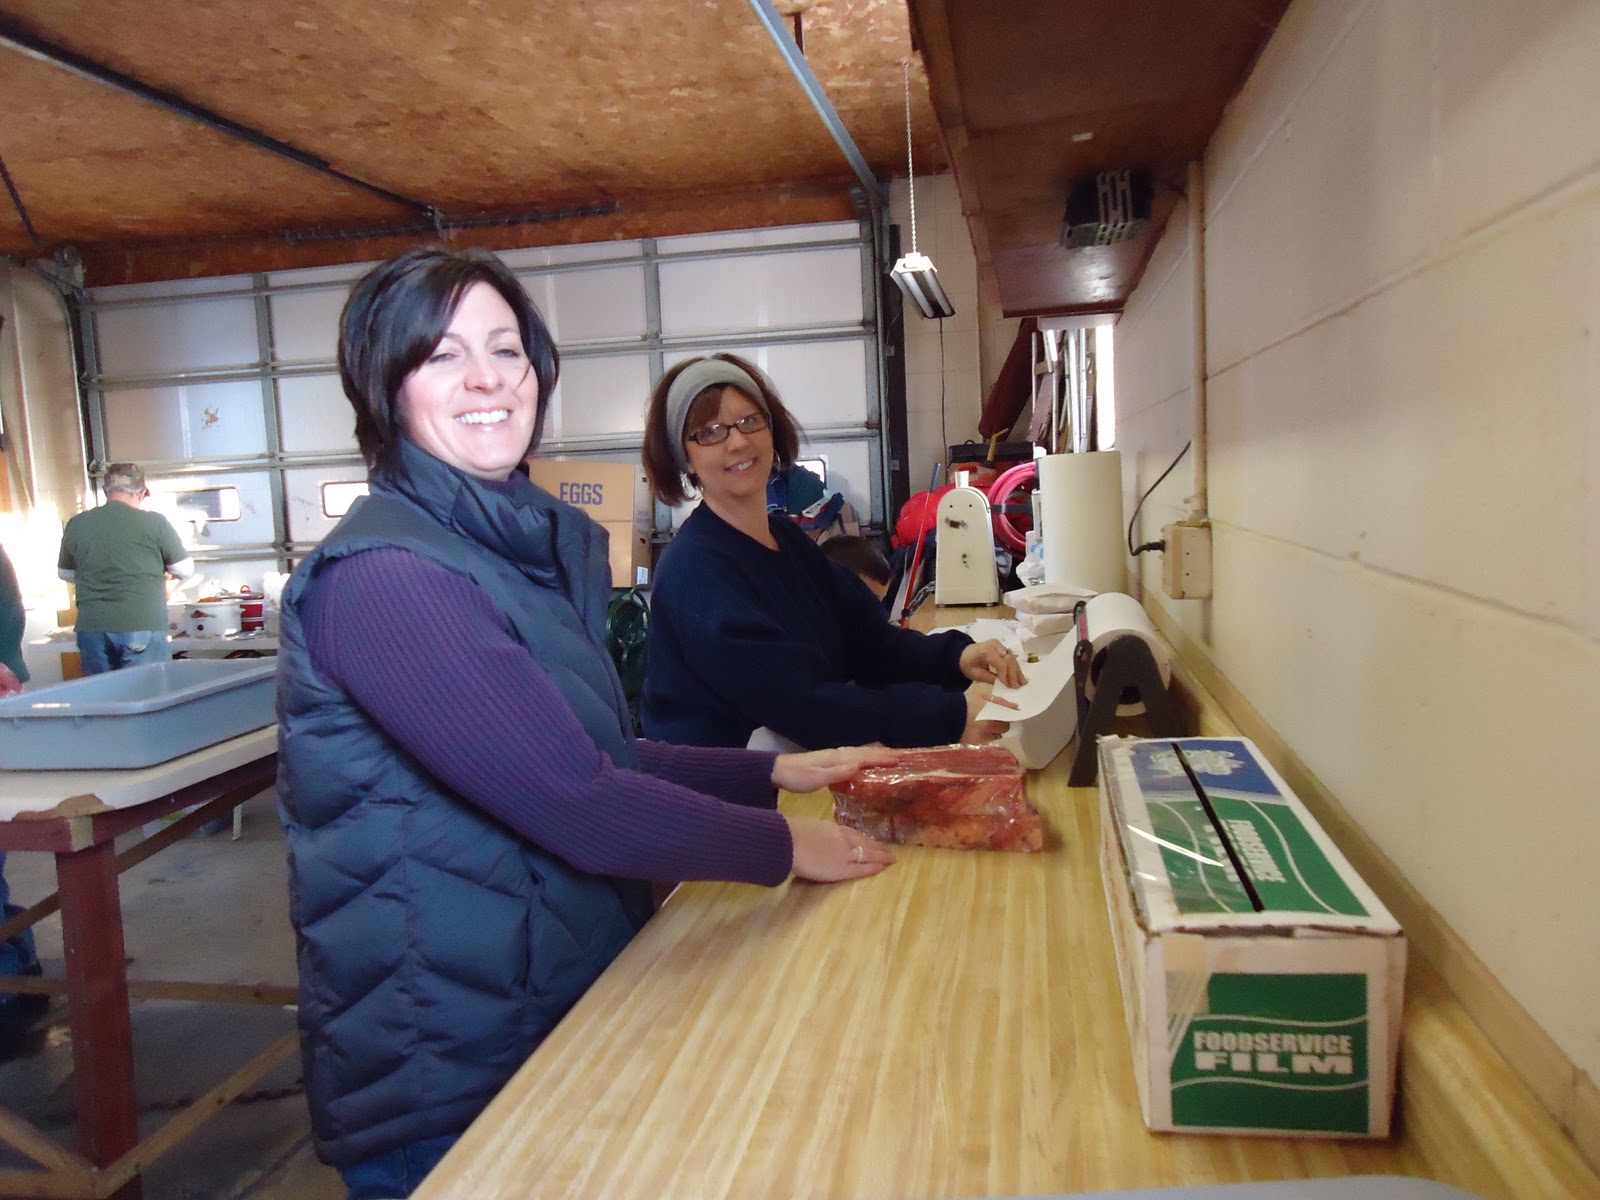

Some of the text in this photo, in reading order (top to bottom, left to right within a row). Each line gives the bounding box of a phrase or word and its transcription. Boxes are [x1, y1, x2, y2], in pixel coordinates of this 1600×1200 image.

[560, 482, 604, 506] EGGS
[1194, 1031, 1353, 1054] FOODSERVICE
[1195, 1051, 1354, 1075] FILM
